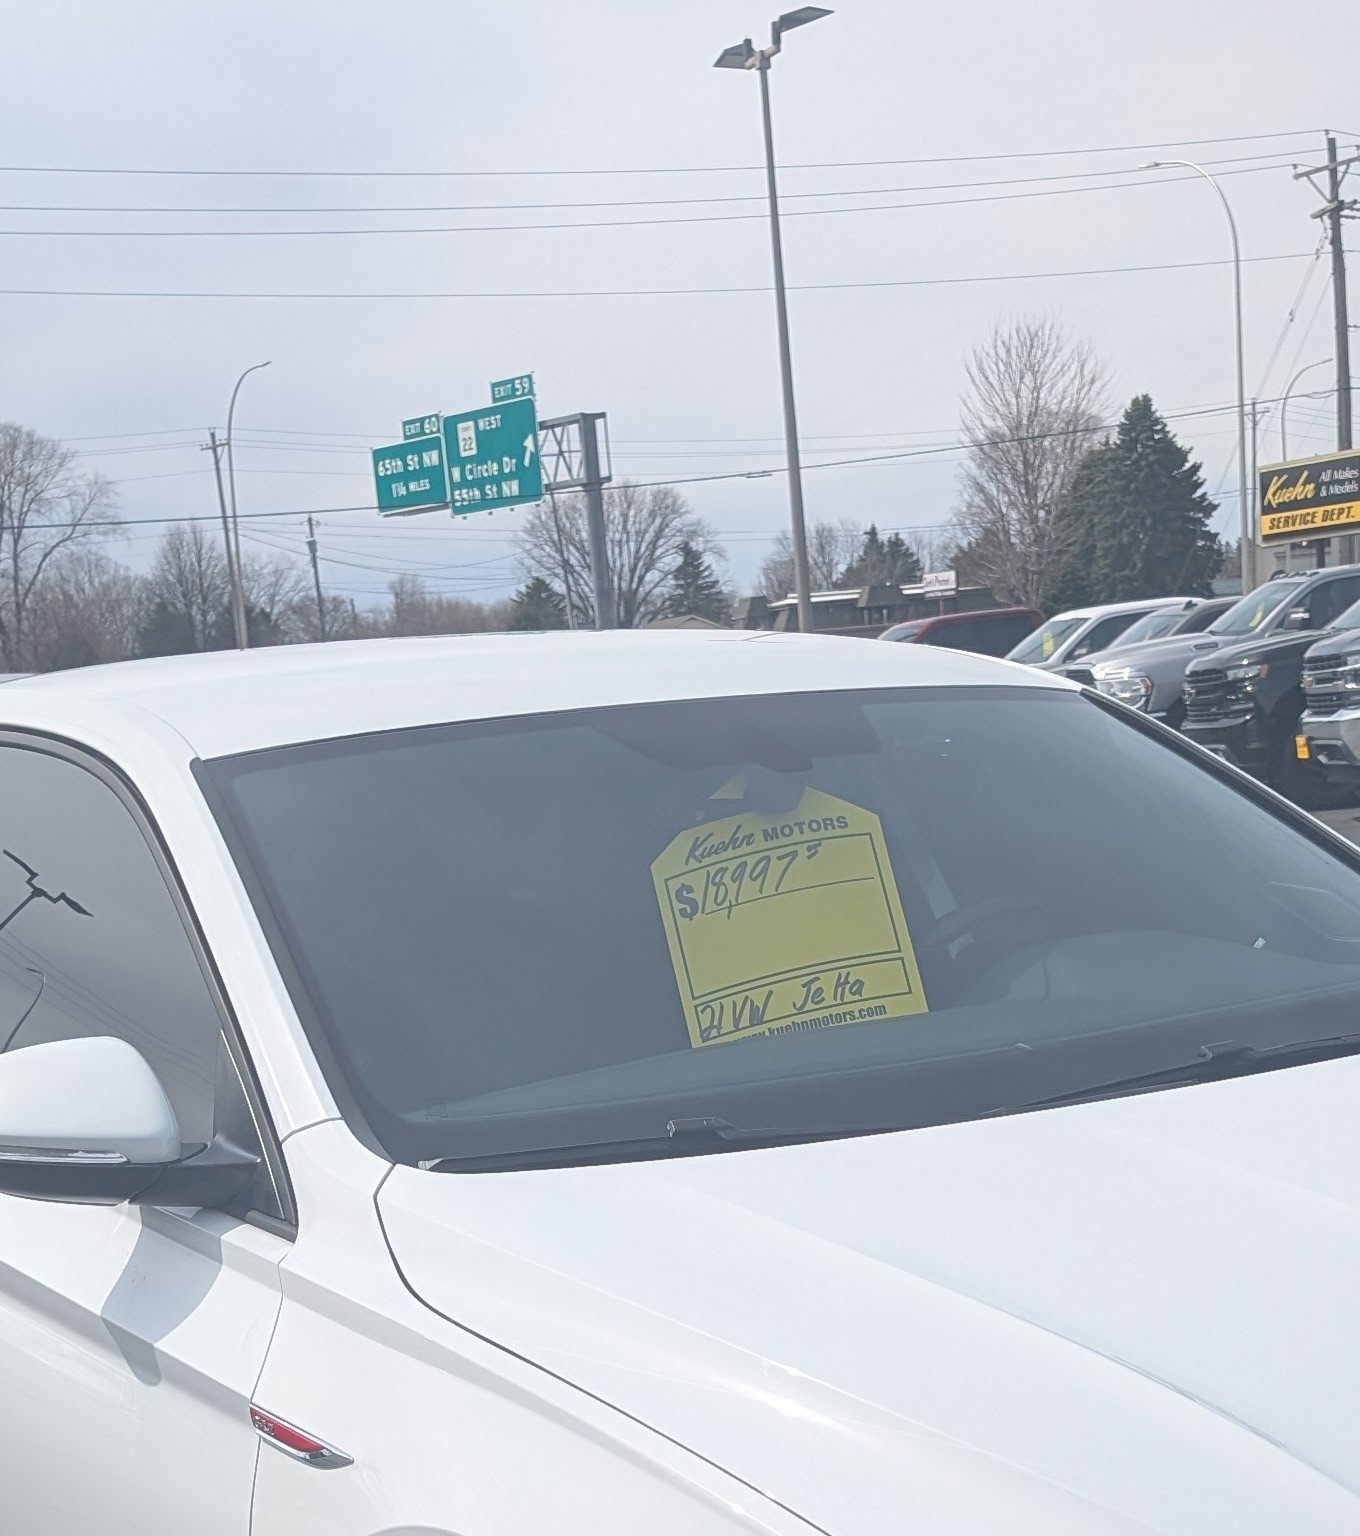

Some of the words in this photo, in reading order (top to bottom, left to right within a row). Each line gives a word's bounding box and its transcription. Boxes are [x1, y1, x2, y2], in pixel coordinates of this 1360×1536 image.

[494, 384, 512, 398] EXIT
[514, 378, 529, 395] 59
[405, 423, 420, 435] EXIT
[424, 417, 438, 433] 60
[477, 415, 501, 431] WEST
[461, 436, 474, 452] 22
[378, 458, 404, 477] 65th
[406, 454, 419, 471] St
[422, 450, 439, 468] NW
[451, 466, 461, 483] W
[465, 460, 498, 480] Circle
[502, 456, 517, 473] Dr
[1319, 469, 1332, 482] All
[1333, 466, 1360, 480] Makes
[408, 479, 430, 492] MILES
[454, 487, 481, 506] 55th
[485, 484, 498, 499] St
[501, 480, 520, 497] NW
[1263, 470, 1316, 508] Kuehn
[1320, 485, 1328, 497] &
[1328, 480, 1359, 495] Models
[1268, 511, 1318, 531] SERVICE
[1321, 505, 1356, 523] DEPT.
[685, 824, 756, 866] Kuehn
[762, 815, 849, 842] MOTORS
[793, 971, 865, 1012] Jetta
